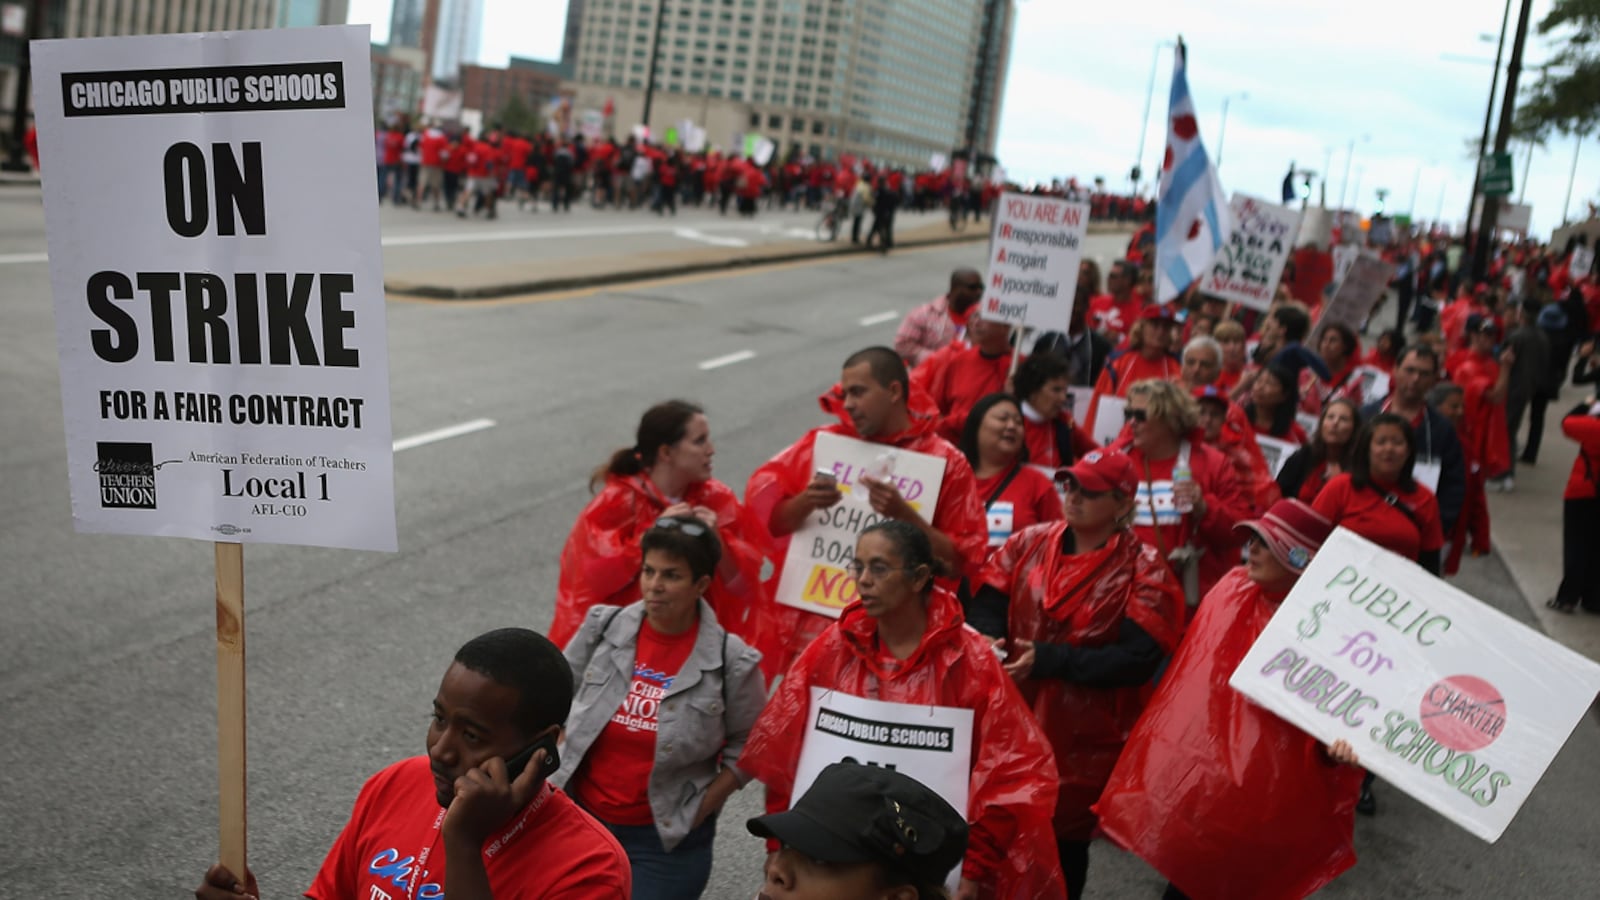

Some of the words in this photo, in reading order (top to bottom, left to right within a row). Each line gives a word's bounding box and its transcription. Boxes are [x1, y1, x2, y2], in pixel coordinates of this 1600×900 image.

[70, 79, 164, 109] CHICAGO
[169, 76, 240, 105] PUBLIC
[244, 72, 338, 103] SCHOOLS
[163, 140, 267, 238] ON
[1007, 199, 1033, 219] YOU
[1034, 203, 1060, 225] ARE
[1062, 207, 1082, 228] AN
[992, 272, 1060, 298] Hypocritical
[86, 270, 360, 368] STRIKE
[99, 389, 148, 420] FOR
[153, 391, 170, 420] A
[174, 392, 222, 424] FAIR
[228, 394, 365, 429] CONTRACT
[188, 450, 238, 465] American
[241, 453, 303, 467] Federation
[305, 455, 318, 467] of
[319, 455, 367, 471] Teachers
[100, 474, 154, 488] TEACHERS
[101, 487, 155, 505] UNION
[221, 468, 307, 499] Local
[317, 472, 331, 501] 1
[251, 504, 307, 517] AFL-CIO
[1325, 565, 1452, 647] PUBLIC
[1297, 600, 1332, 641] $
[1333, 631, 1394, 675] for
[1261, 647, 1379, 728] PUBLIC
[1369, 710, 1511, 807] SCHOOLS
[1429, 684, 1505, 738] CHARTER
[818, 712, 849, 735] CHICAGO
[848, 721, 889, 743] PUBLIC
[890, 728, 950, 748] SCHOOLS
